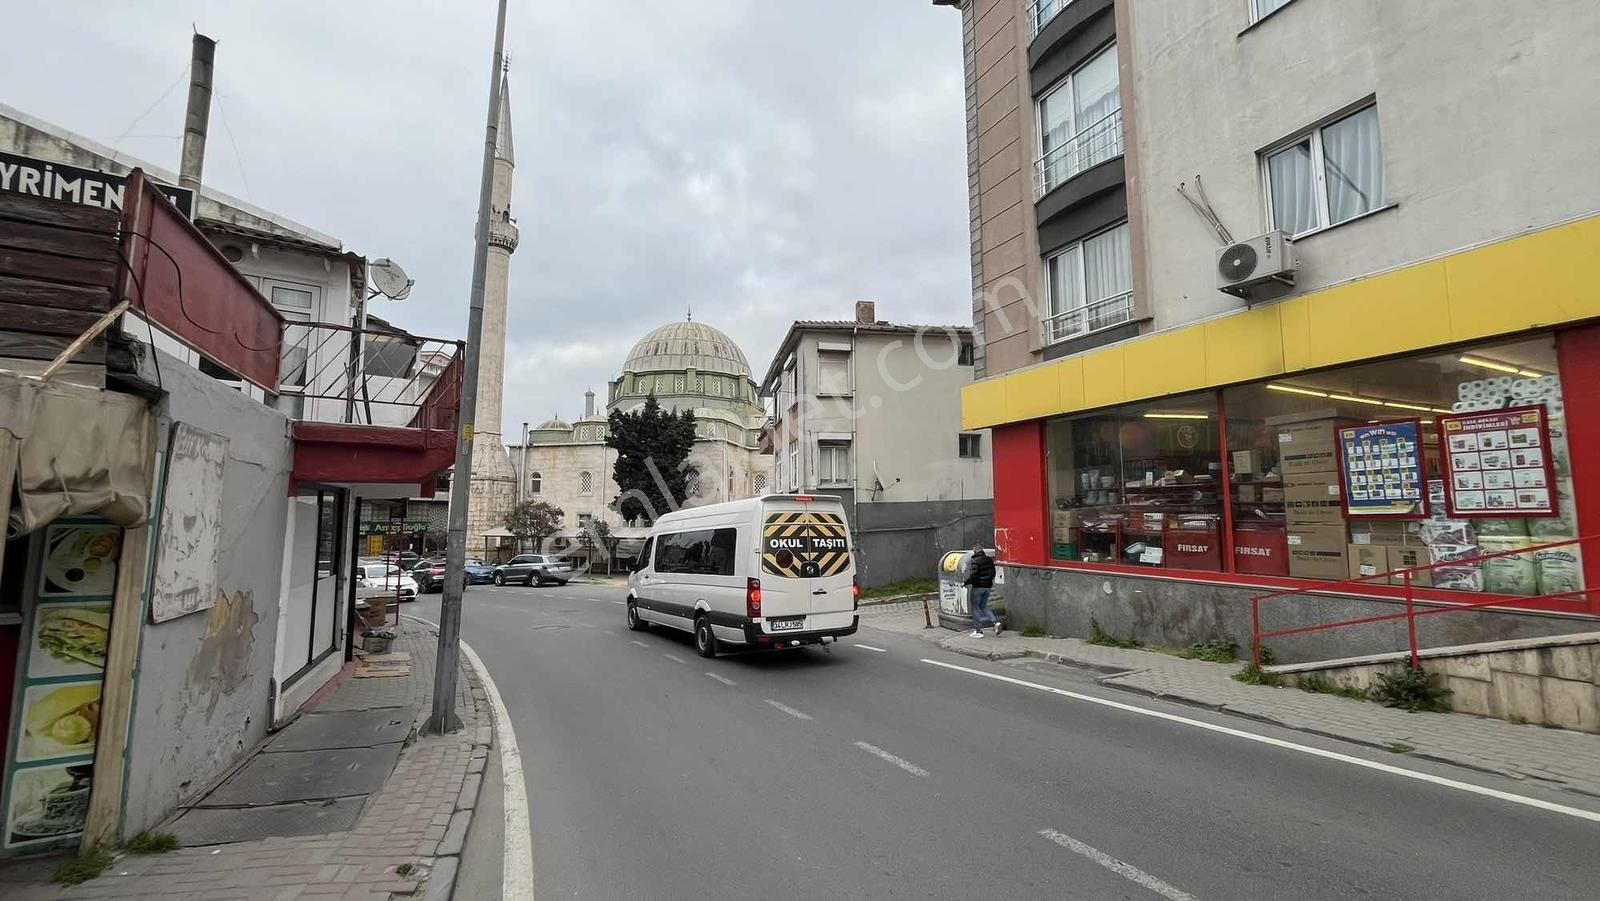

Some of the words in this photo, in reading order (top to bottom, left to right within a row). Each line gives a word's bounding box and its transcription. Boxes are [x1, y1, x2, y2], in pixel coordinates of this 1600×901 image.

[770, 538, 804, 549] OKUL
[812, 538, 845, 549] TAŞITI
[1177, 543, 1209, 553] FIRSAT
[1234, 546, 1272, 556] FIRSAT
